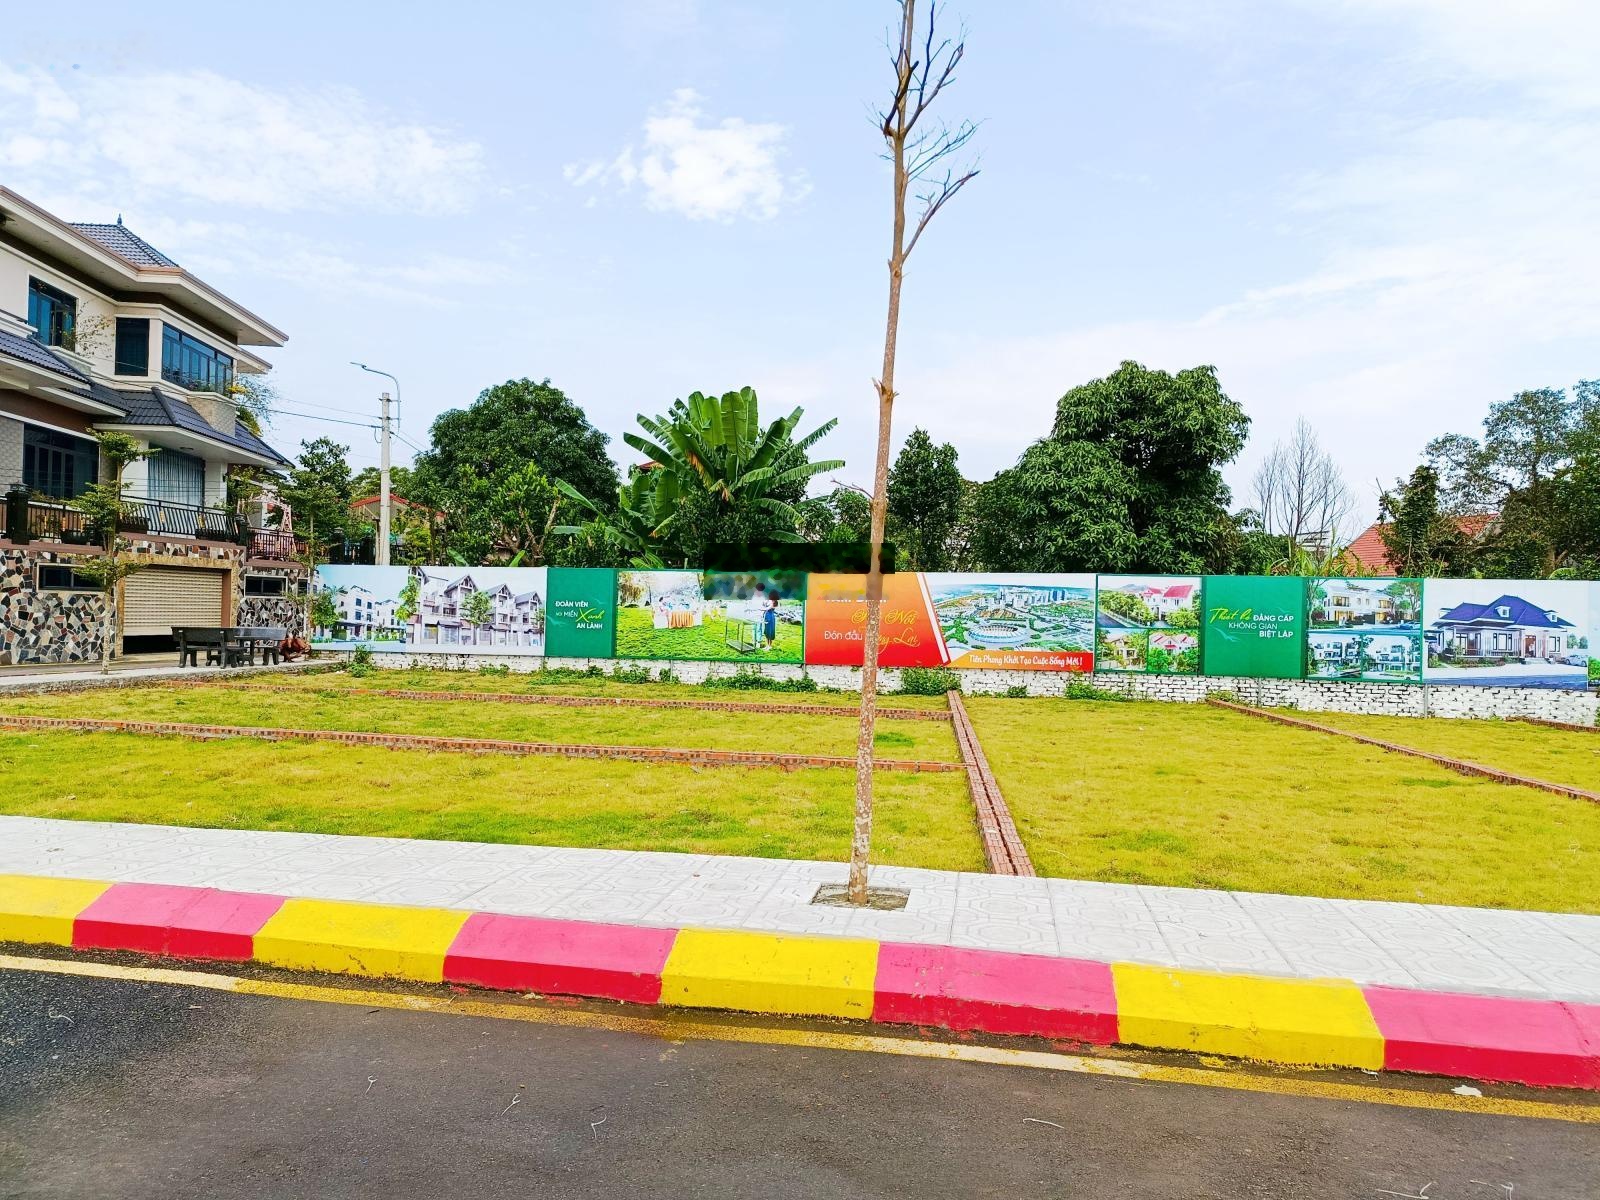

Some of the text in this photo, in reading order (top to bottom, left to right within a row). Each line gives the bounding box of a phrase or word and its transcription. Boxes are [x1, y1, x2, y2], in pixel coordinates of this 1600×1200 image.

[1228, 621, 1278, 630] KHÔNG GIAN
[1259, 630, 1276, 639] BIỆT
